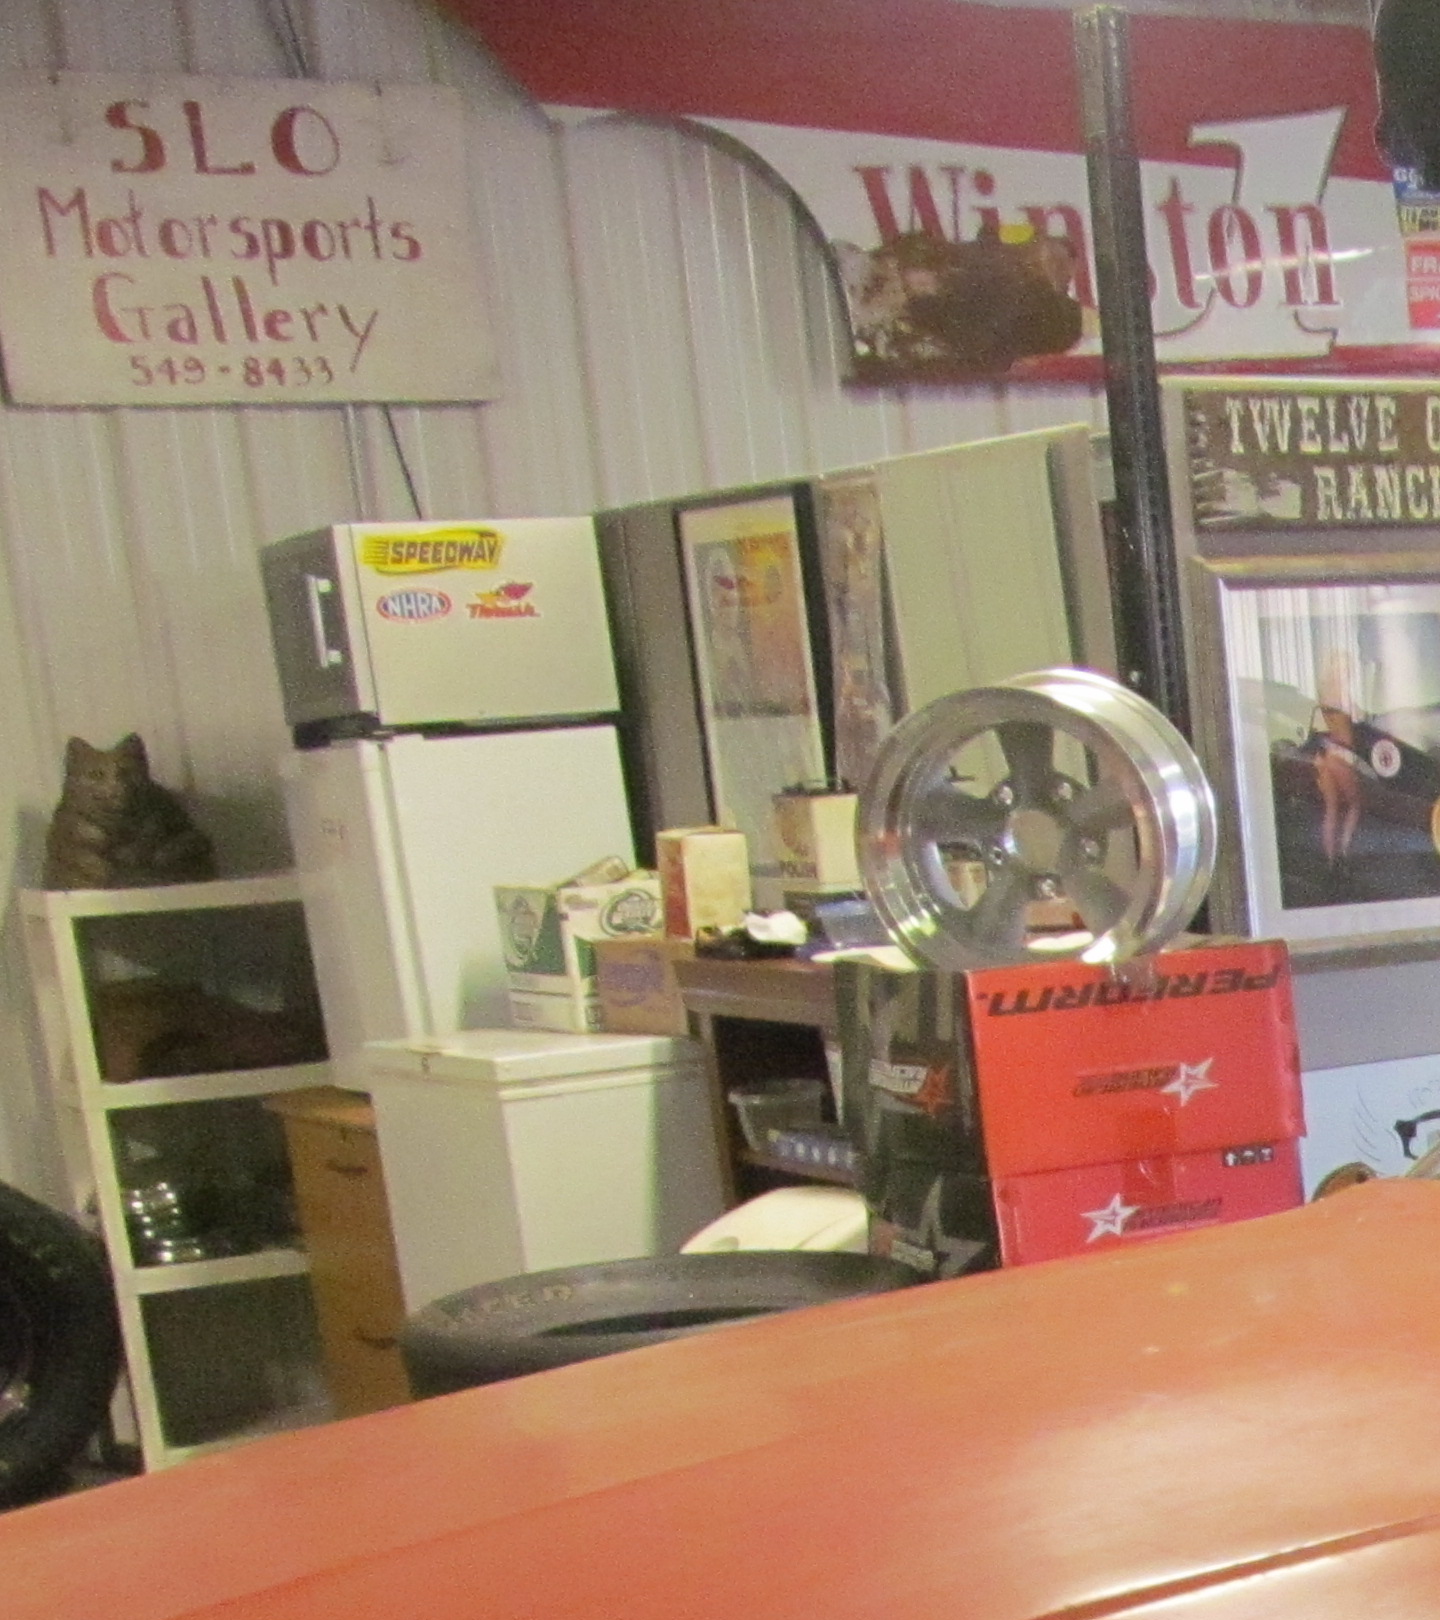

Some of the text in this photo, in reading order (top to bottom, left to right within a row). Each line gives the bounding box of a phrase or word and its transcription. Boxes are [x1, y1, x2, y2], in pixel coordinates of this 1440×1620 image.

[106, 101, 341, 175] SLO
[37, 186, 424, 286] Motorsports
[853, 163, 1342, 310] Winton
[92, 271, 379, 372] Gallery
[130, 355, 335, 388] 549-8433
[1226, 396, 1400, 454] TWELVE
[390, 537, 499, 566] SPEEDWAY
[387, 591, 446, 619] NHRA
